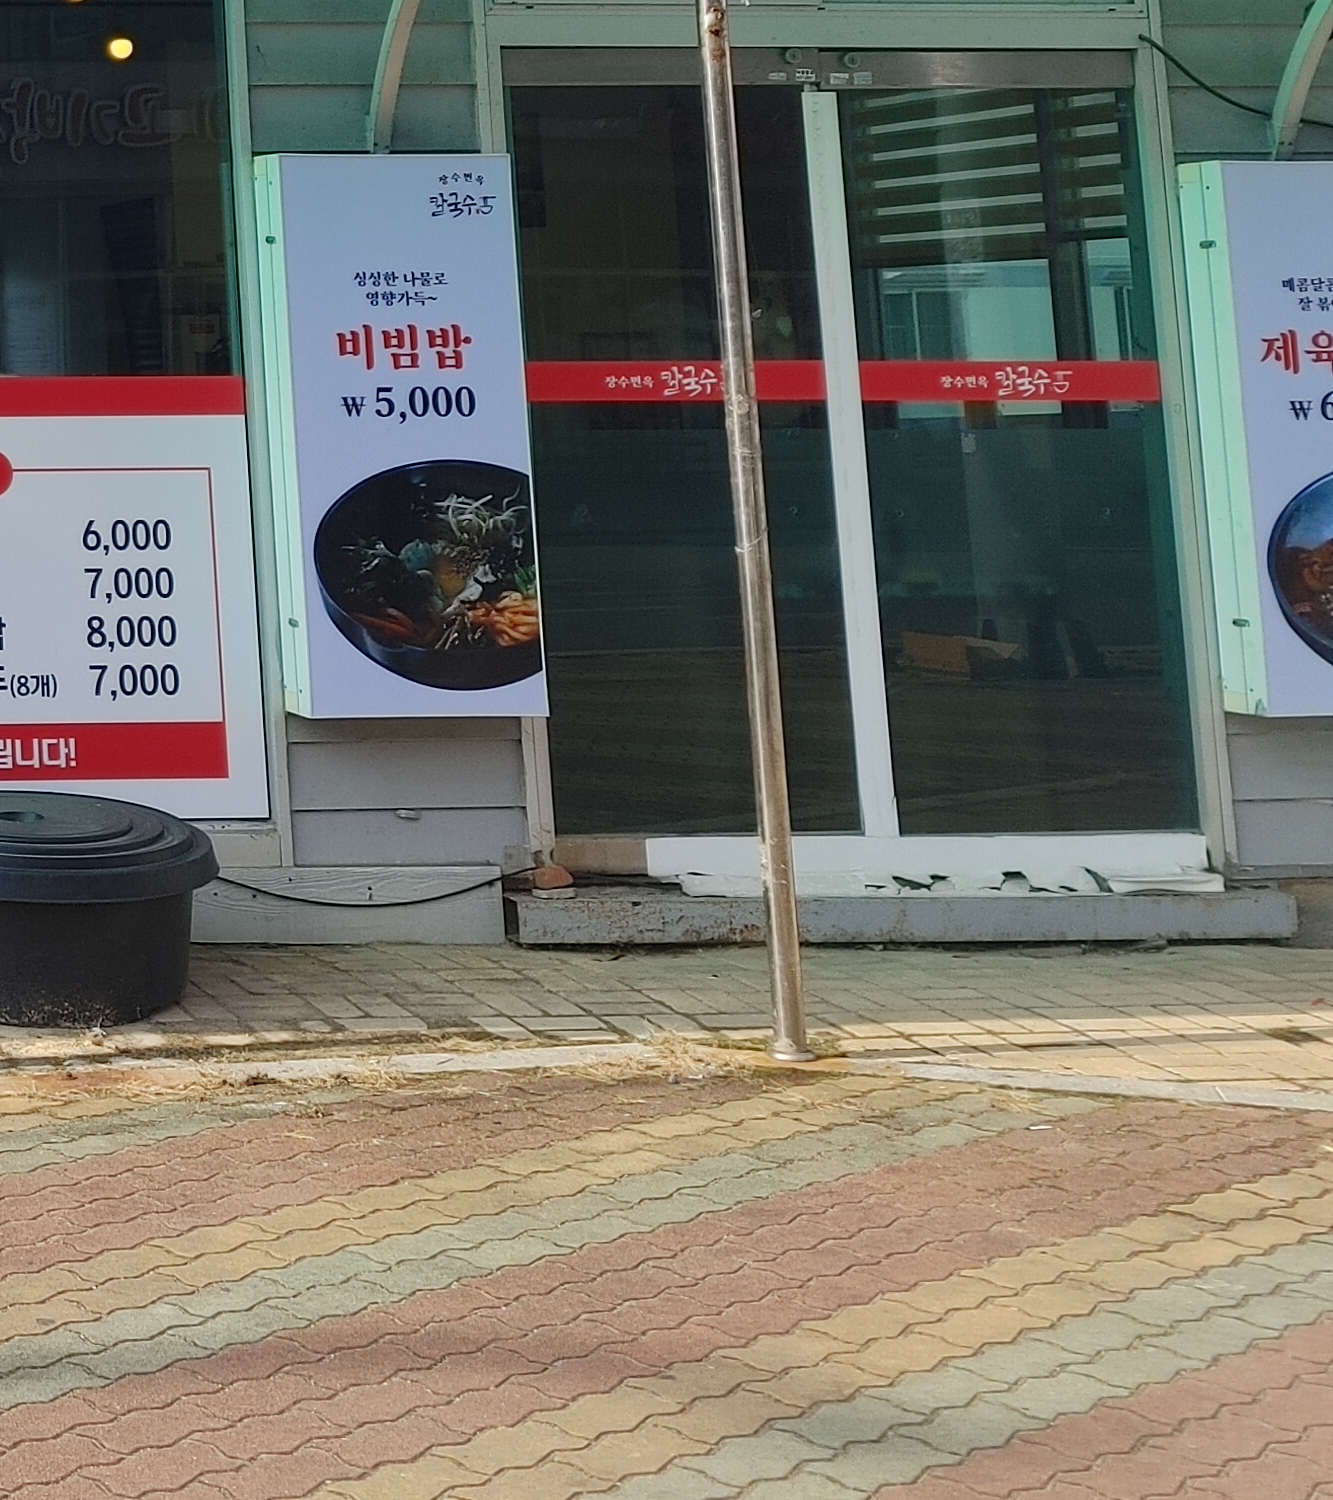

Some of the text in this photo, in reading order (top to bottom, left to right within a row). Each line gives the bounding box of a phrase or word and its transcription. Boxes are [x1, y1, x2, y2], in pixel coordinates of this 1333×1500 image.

[429, 192, 477, 218] 칼국수
[353, 271, 449, 287] 싱싱한 나물로
[1298, 297, 1333, 312] 잘 볶
[336, 324, 472, 371] 비빔밥
[1261, 329, 1333, 375] 제육
[661, 366, 718, 397] 칼국수
[995, 366, 1051, 397] 칼국수
[82, 519, 172, 556] 6,000
[83, 567, 174, 604] 7,000
[86, 615, 177, 653] 8,000
[88, 663, 180, 701] 7,000
